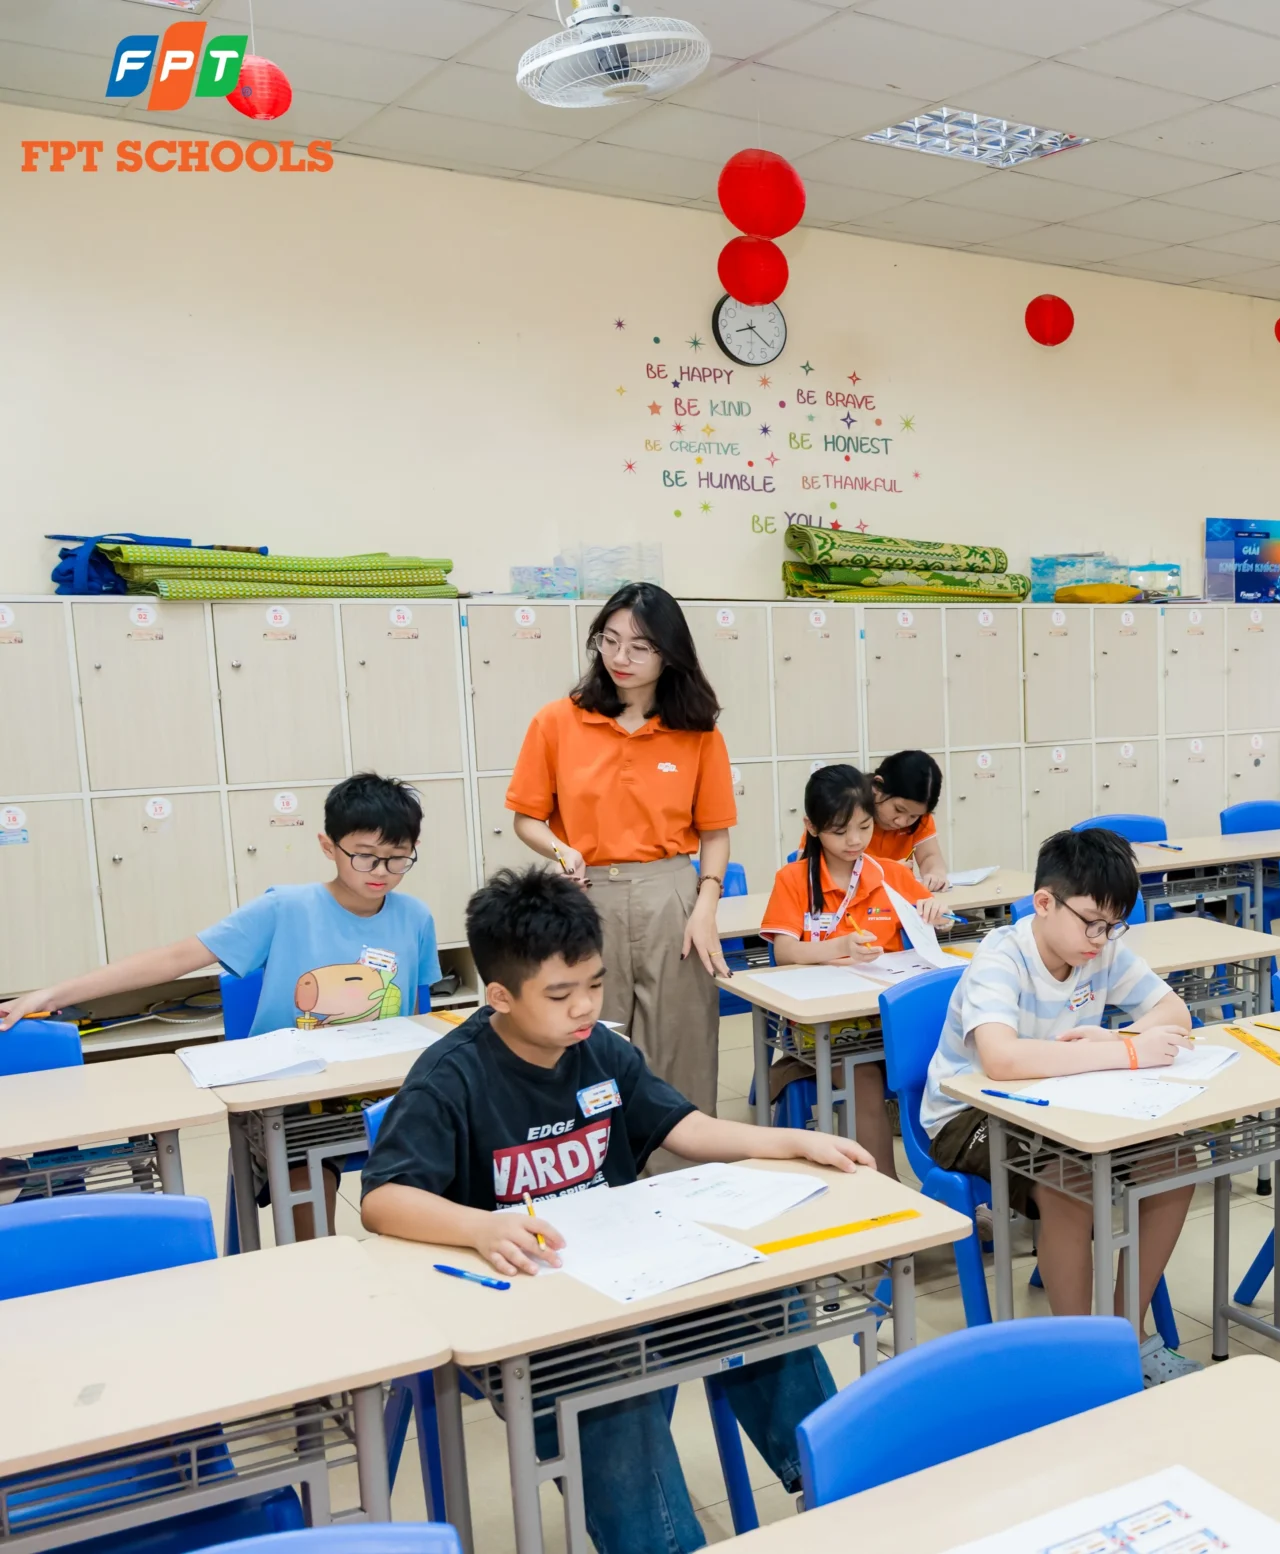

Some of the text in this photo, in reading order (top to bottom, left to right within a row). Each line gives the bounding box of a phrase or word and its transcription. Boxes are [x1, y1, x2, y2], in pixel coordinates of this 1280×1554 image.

[725, 308, 736, 318] 10
[768, 312, 776, 323] 2
[720, 319, 728, 329] 9
[774, 326, 780, 337] 3
[726, 333, 732, 344] 8
[736, 345, 742, 355] 7
[747, 351, 755, 361] 6
[760, 348, 767, 359] 5
[646, 363, 734, 385] BE HAPPY
[674, 397, 752, 417] BE KIND
[796, 388, 876, 410] BE BRAVE
[645, 439, 741, 456] BE CREATIVE
[788, 432, 893, 455] BE HONEST
[662, 469, 776, 492] BE HUMBLE
[802, 473, 903, 493] BE THANKFUL
[751, 514, 777, 534] BE
[527, 1118, 575, 1141] EDGE
[493, 1126, 611, 1196] ARDE
